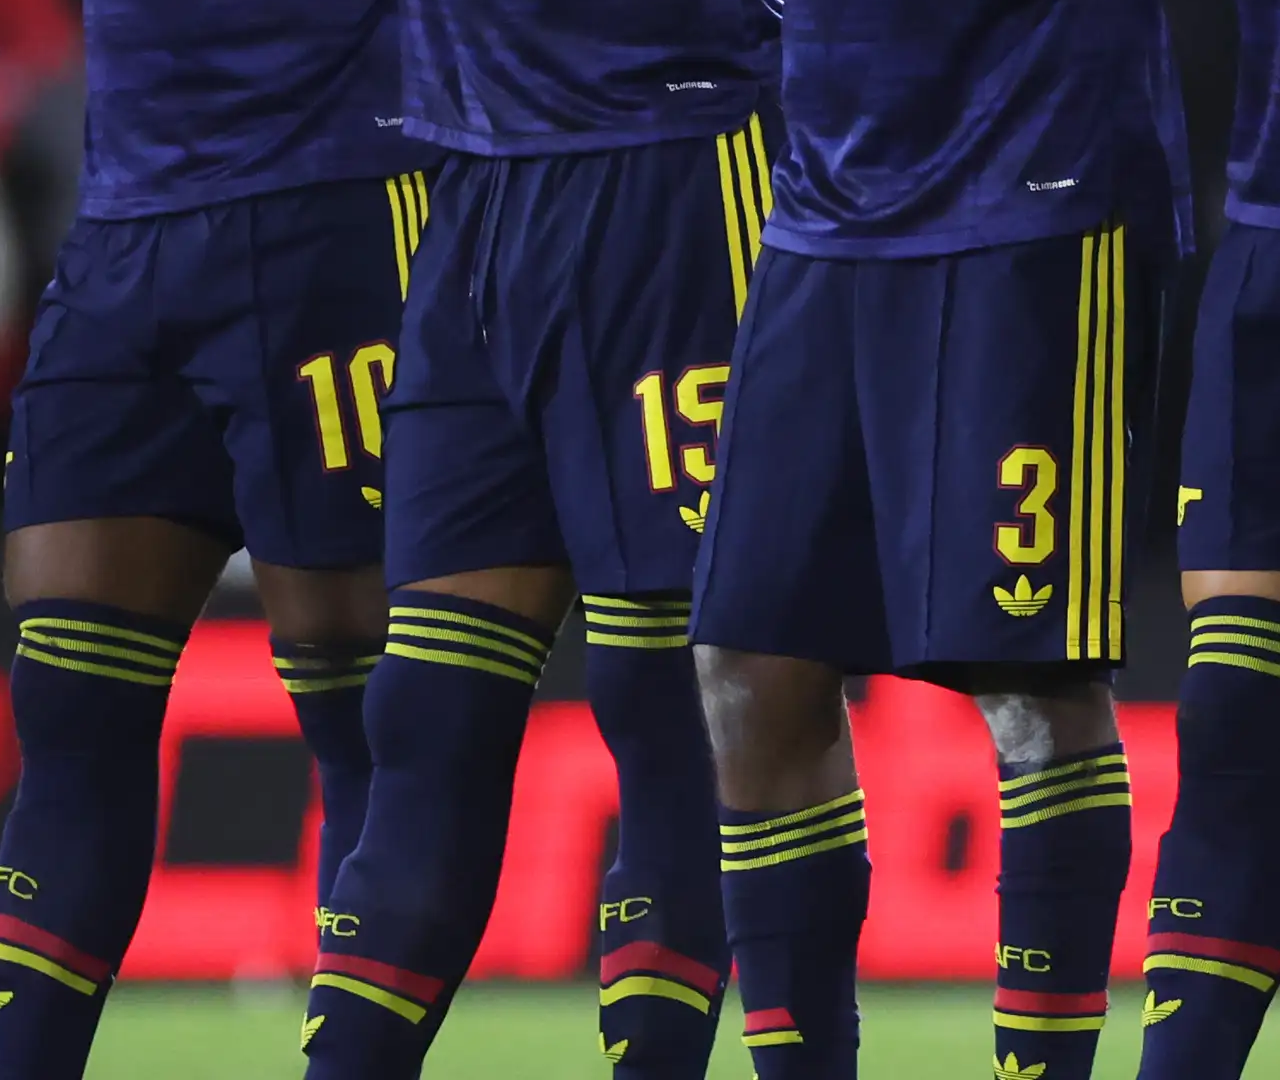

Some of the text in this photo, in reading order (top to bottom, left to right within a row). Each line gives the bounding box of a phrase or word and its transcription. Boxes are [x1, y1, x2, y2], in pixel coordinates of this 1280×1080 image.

[297, 340, 398, 471] 10
[634, 364, 732, 492] 15
[993, 444, 1061, 567] 3
[600, 896, 652, 932] FC
[1148, 897, 1203, 920] FC
